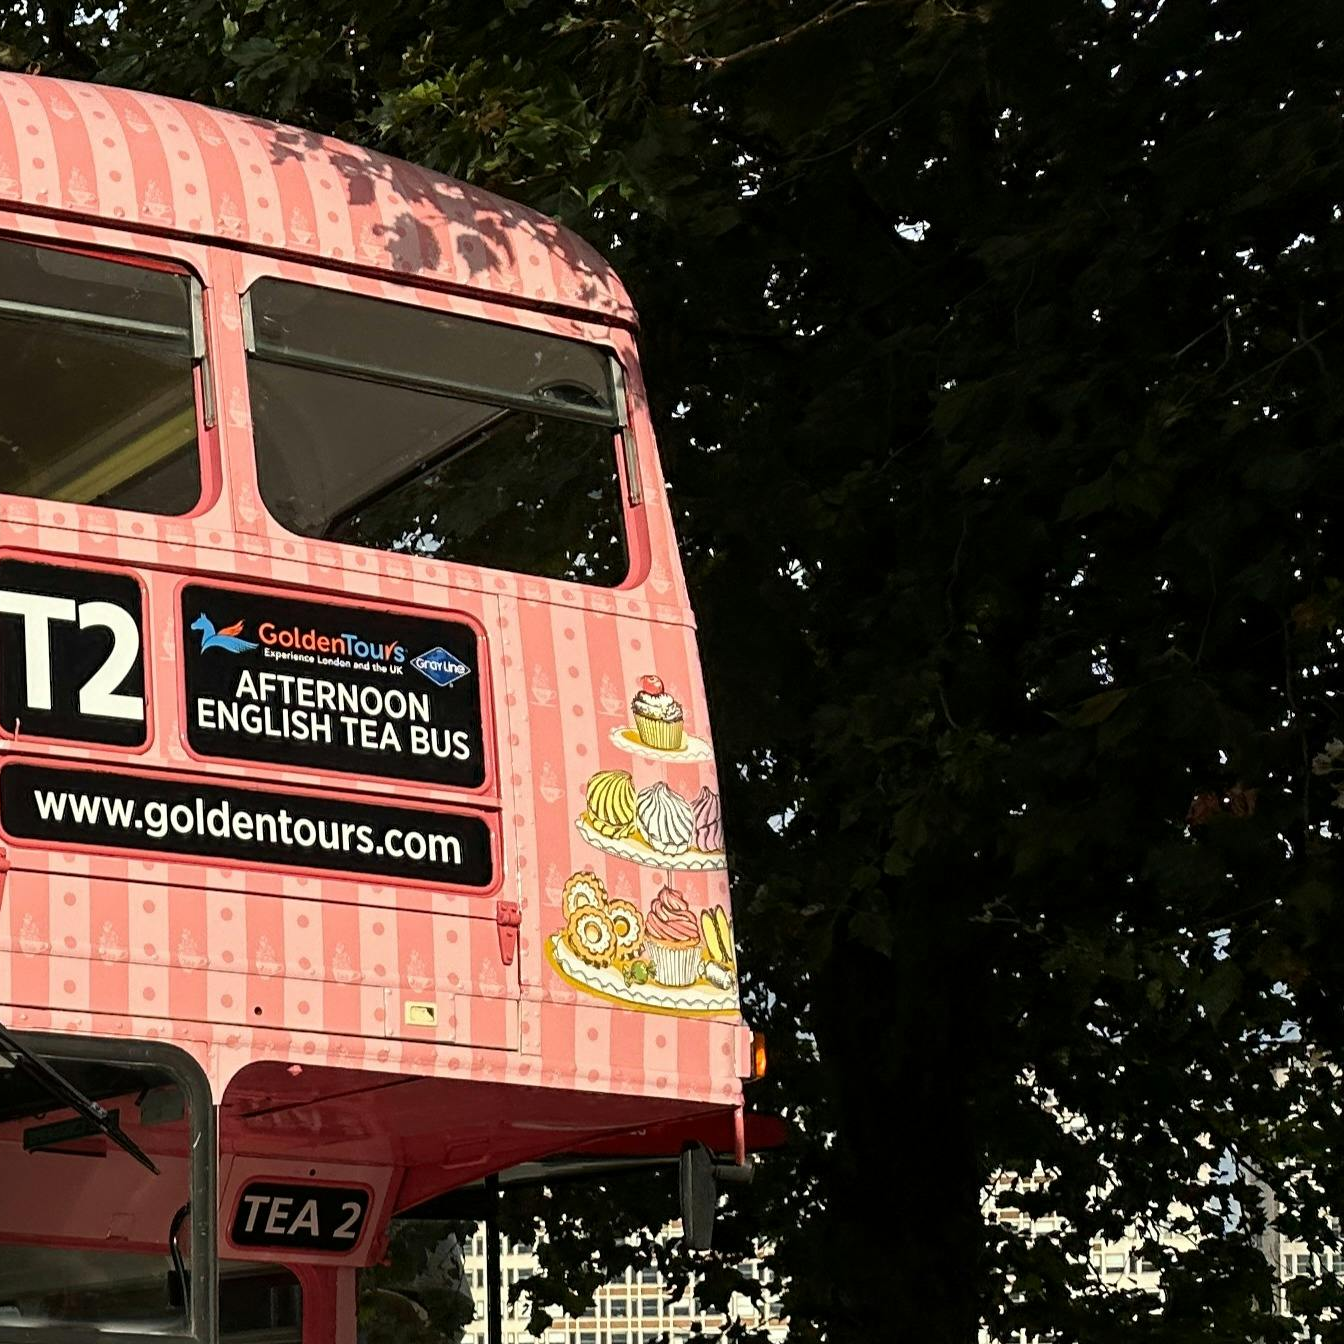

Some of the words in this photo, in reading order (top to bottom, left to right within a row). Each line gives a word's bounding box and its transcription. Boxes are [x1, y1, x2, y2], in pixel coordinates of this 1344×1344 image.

[264, 649, 315, 664] Experience
[317, 655, 351, 669] London
[354, 660, 371, 672] and
[372, 663, 388, 674] the
[389, 665, 404, 676] UK
[235, 670, 429, 723] AFTERNOON
[197, 699, 331, 741] ENGLISH
[340, 716, 401, 752] TEA
[411, 726, 470, 761] BUS
[34, 788, 461, 865] www.goldentours.com
[244, 1195, 320, 1237] TEA
[332, 1201, 362, 1239] 2
